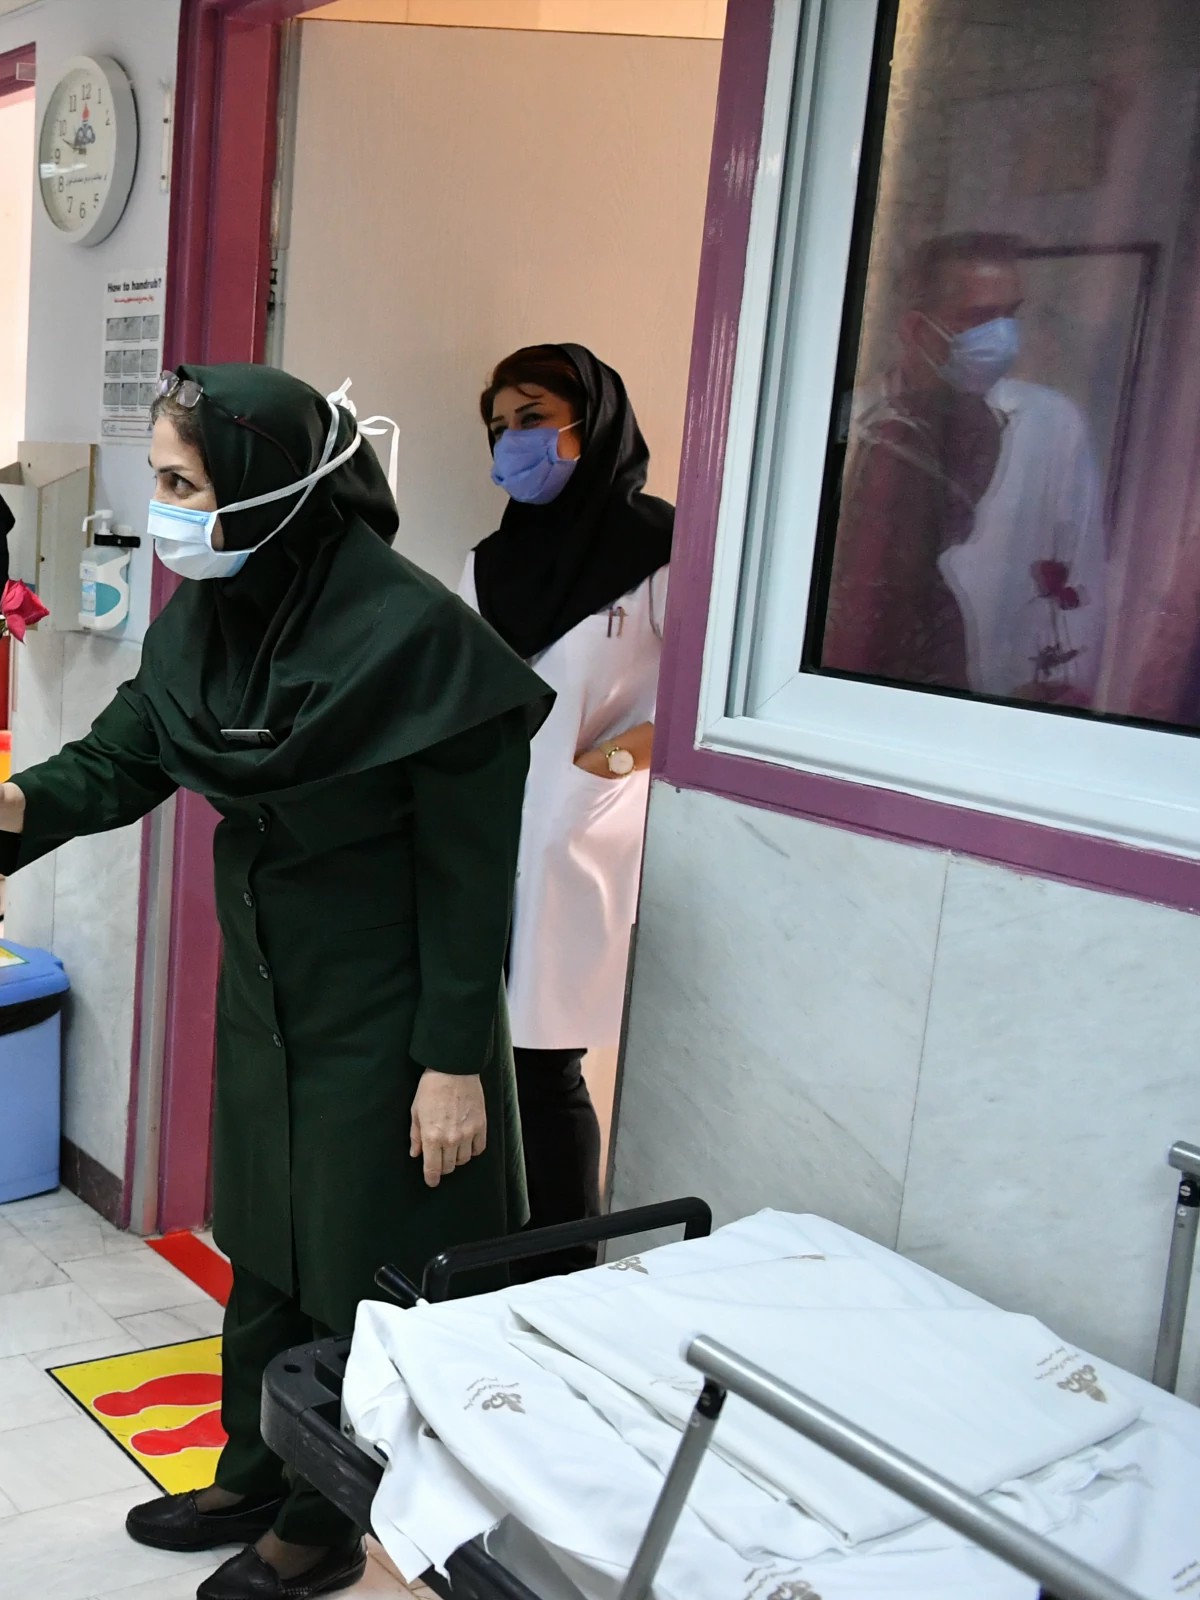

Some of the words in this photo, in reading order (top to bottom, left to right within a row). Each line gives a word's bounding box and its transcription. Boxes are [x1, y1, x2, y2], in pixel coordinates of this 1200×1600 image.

[81, 82, 92, 101] 12
[69, 94, 77, 113] 11
[67, 196, 73, 213] 7
[80, 202, 86, 219] 6
[107, 282, 121, 293] How
[123, 281, 130, 291] to
[132, 277, 162, 291] handrub?
